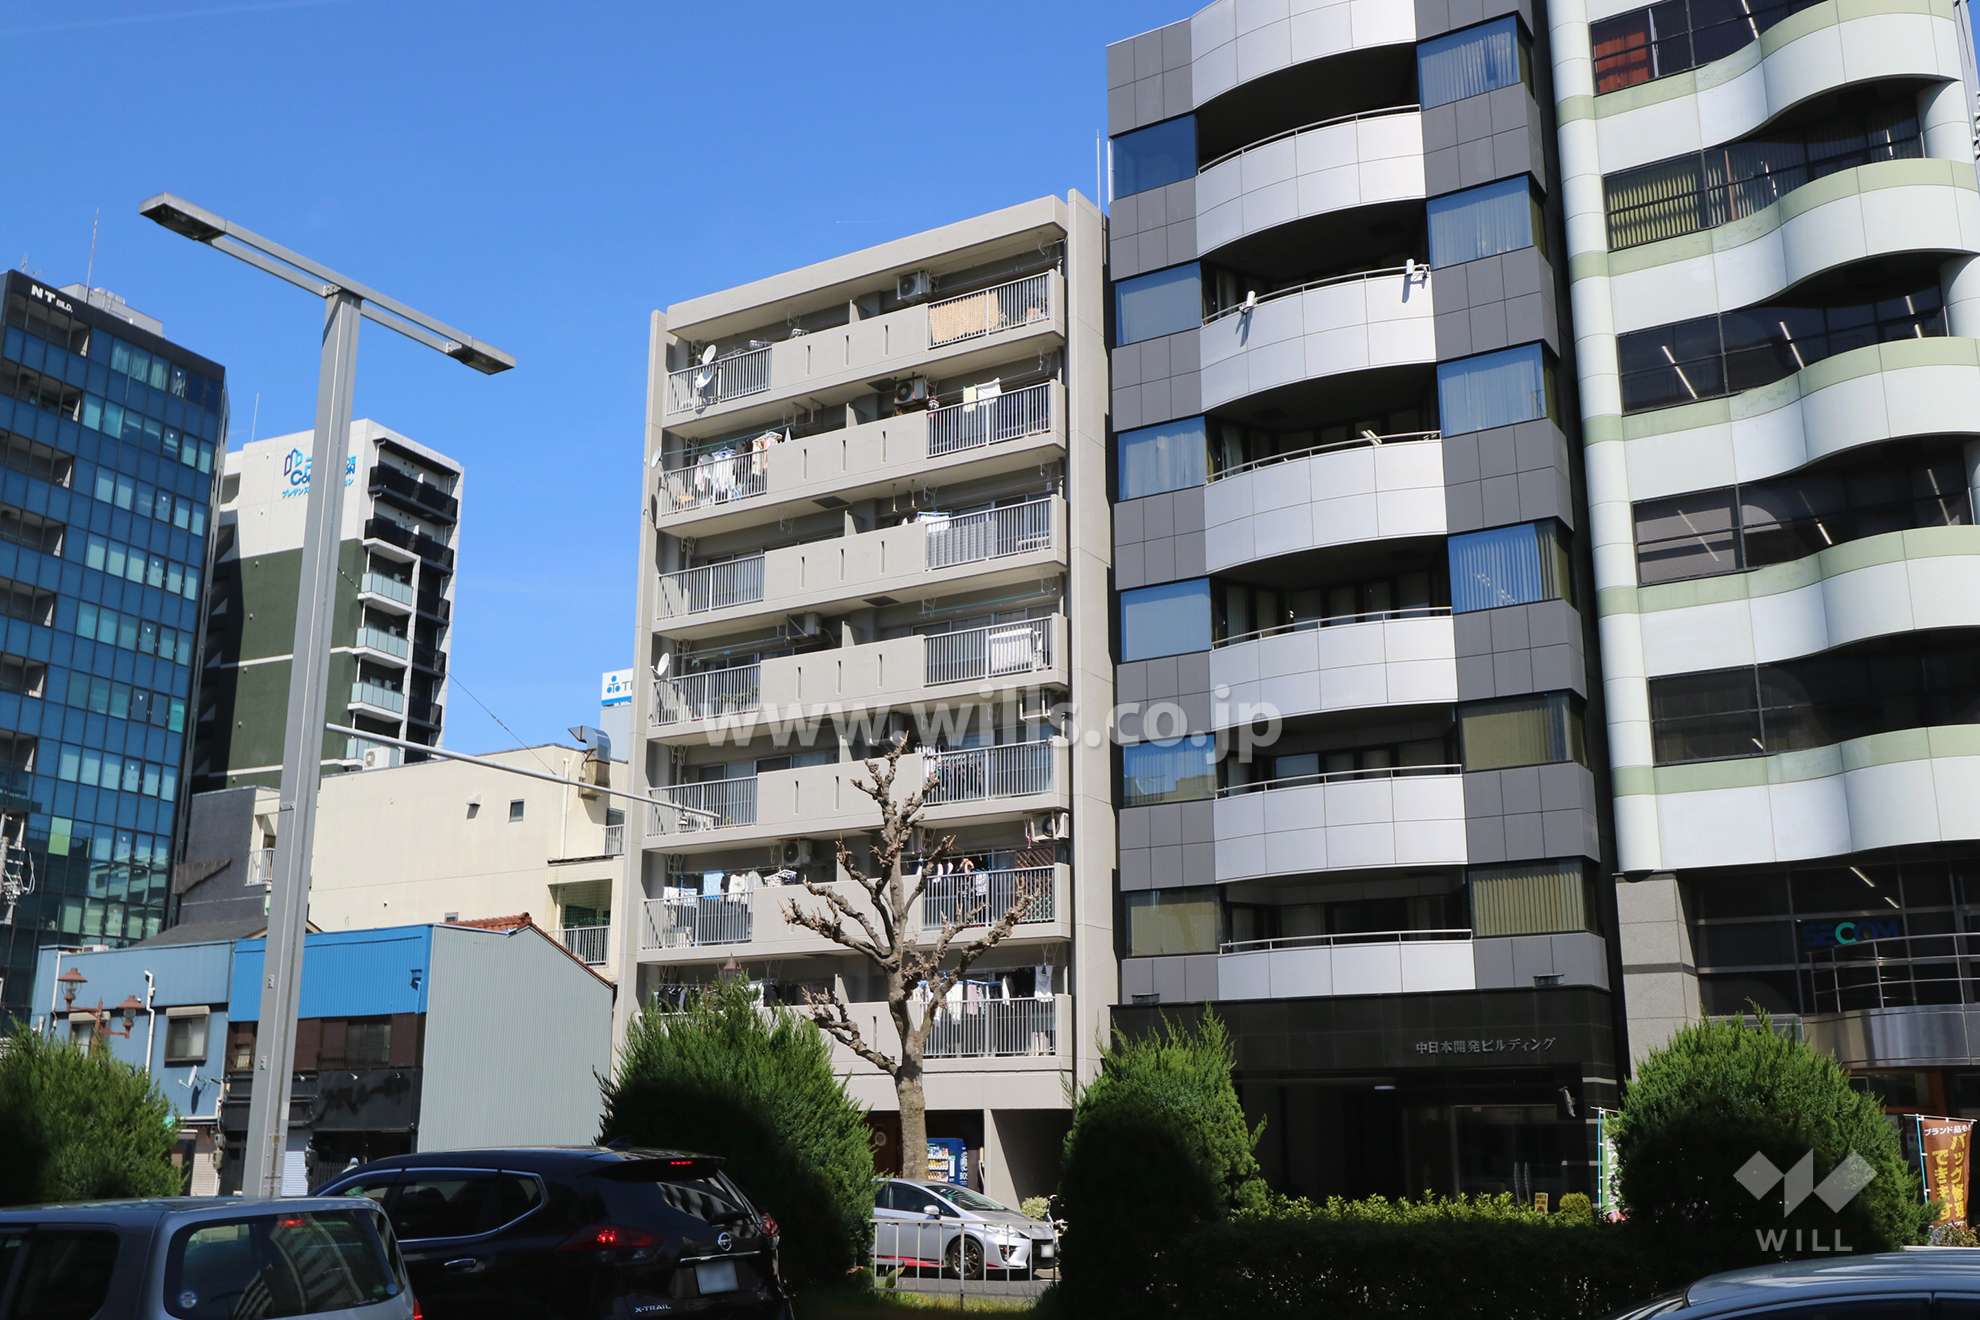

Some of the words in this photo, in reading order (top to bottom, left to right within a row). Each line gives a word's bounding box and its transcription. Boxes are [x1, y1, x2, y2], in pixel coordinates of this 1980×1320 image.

[1416, 1036, 1556, 1054] 中日本開発ビルディング
[1932, 1149, 1952, 1221] できます
[634, 1303, 672, 1313] X-TRAIL
